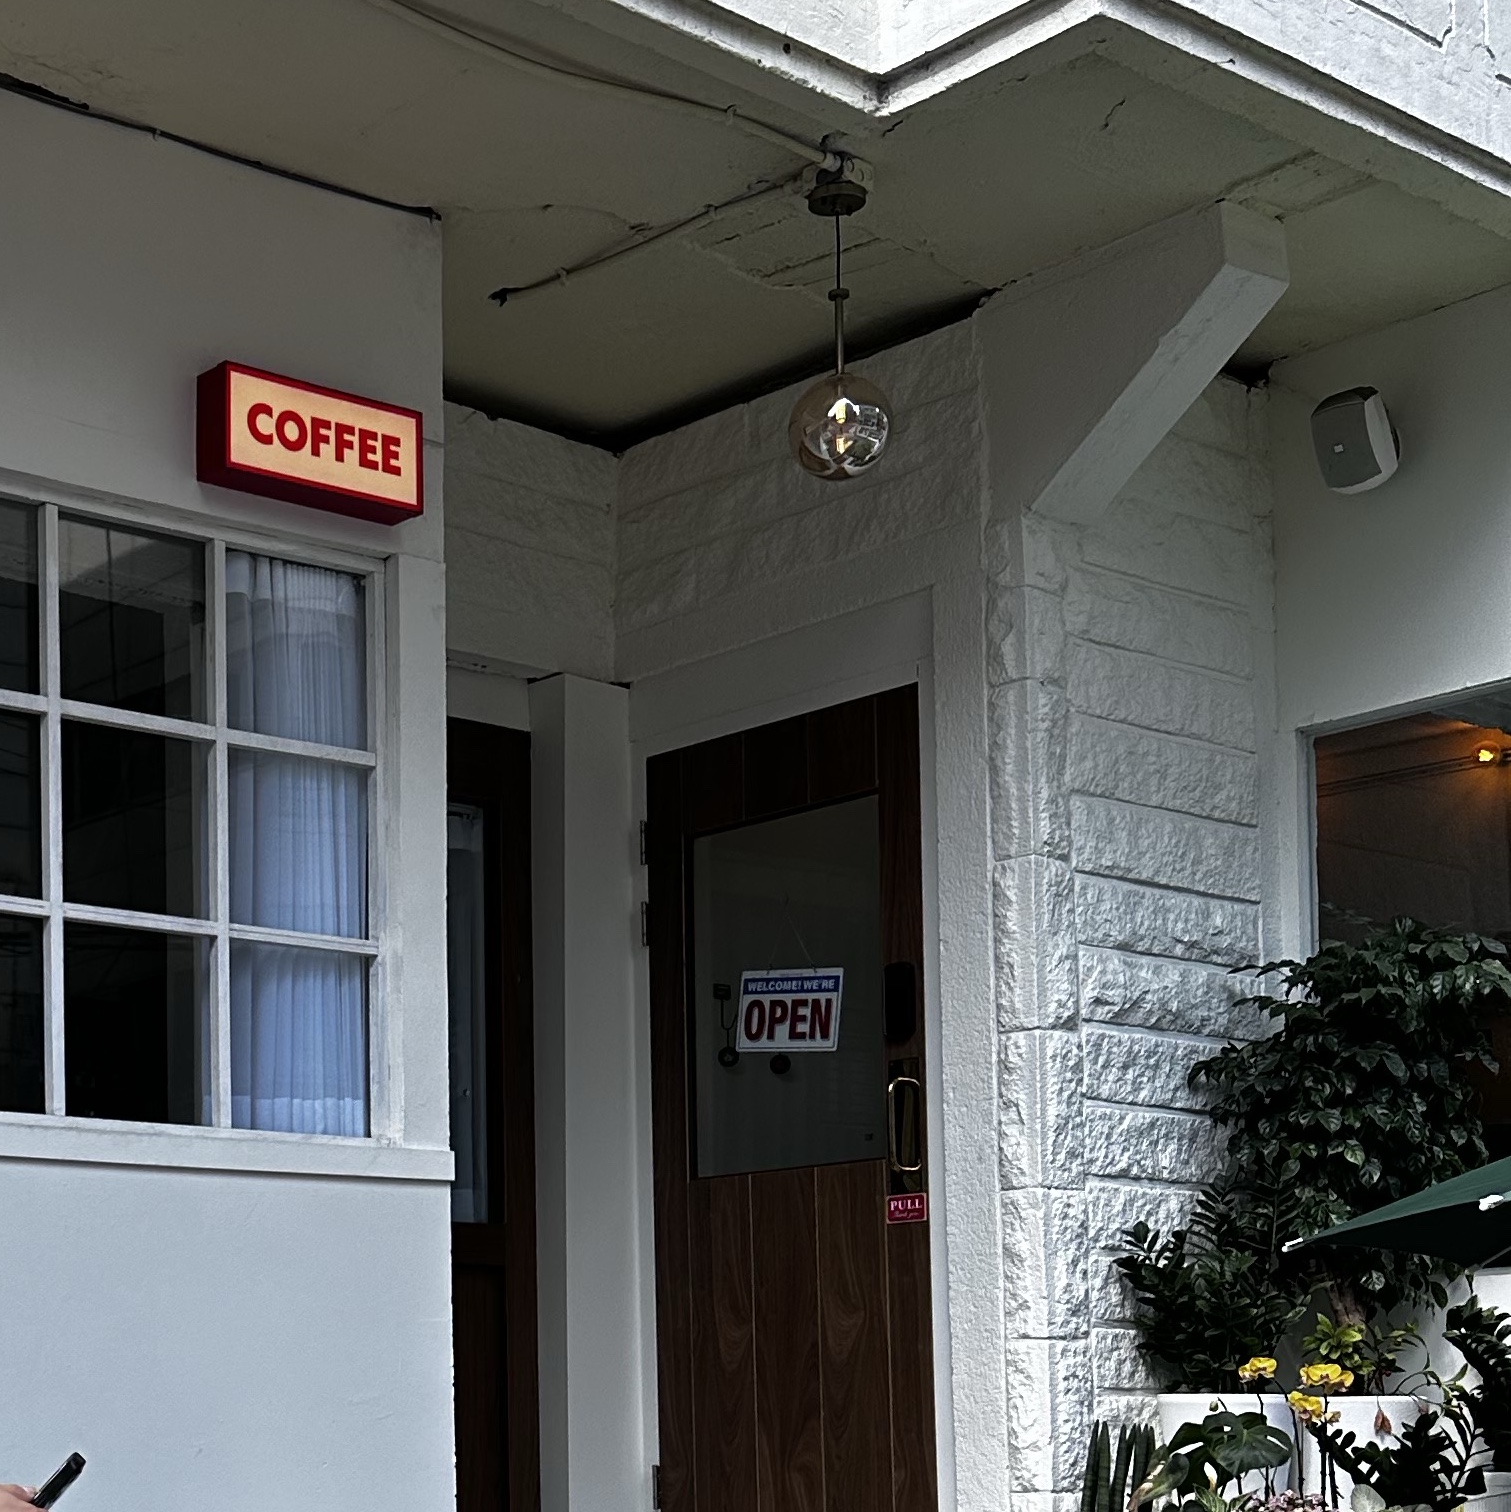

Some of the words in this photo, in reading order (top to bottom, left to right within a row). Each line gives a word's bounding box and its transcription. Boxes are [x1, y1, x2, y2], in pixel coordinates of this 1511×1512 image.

[247, 402, 402, 477] COFFEE
[748, 981, 802, 993] WELCOME!
[803, 979, 835, 991] WE'RE
[744, 998, 833, 1043] OPEN
[890, 1199, 923, 1211] PULL
